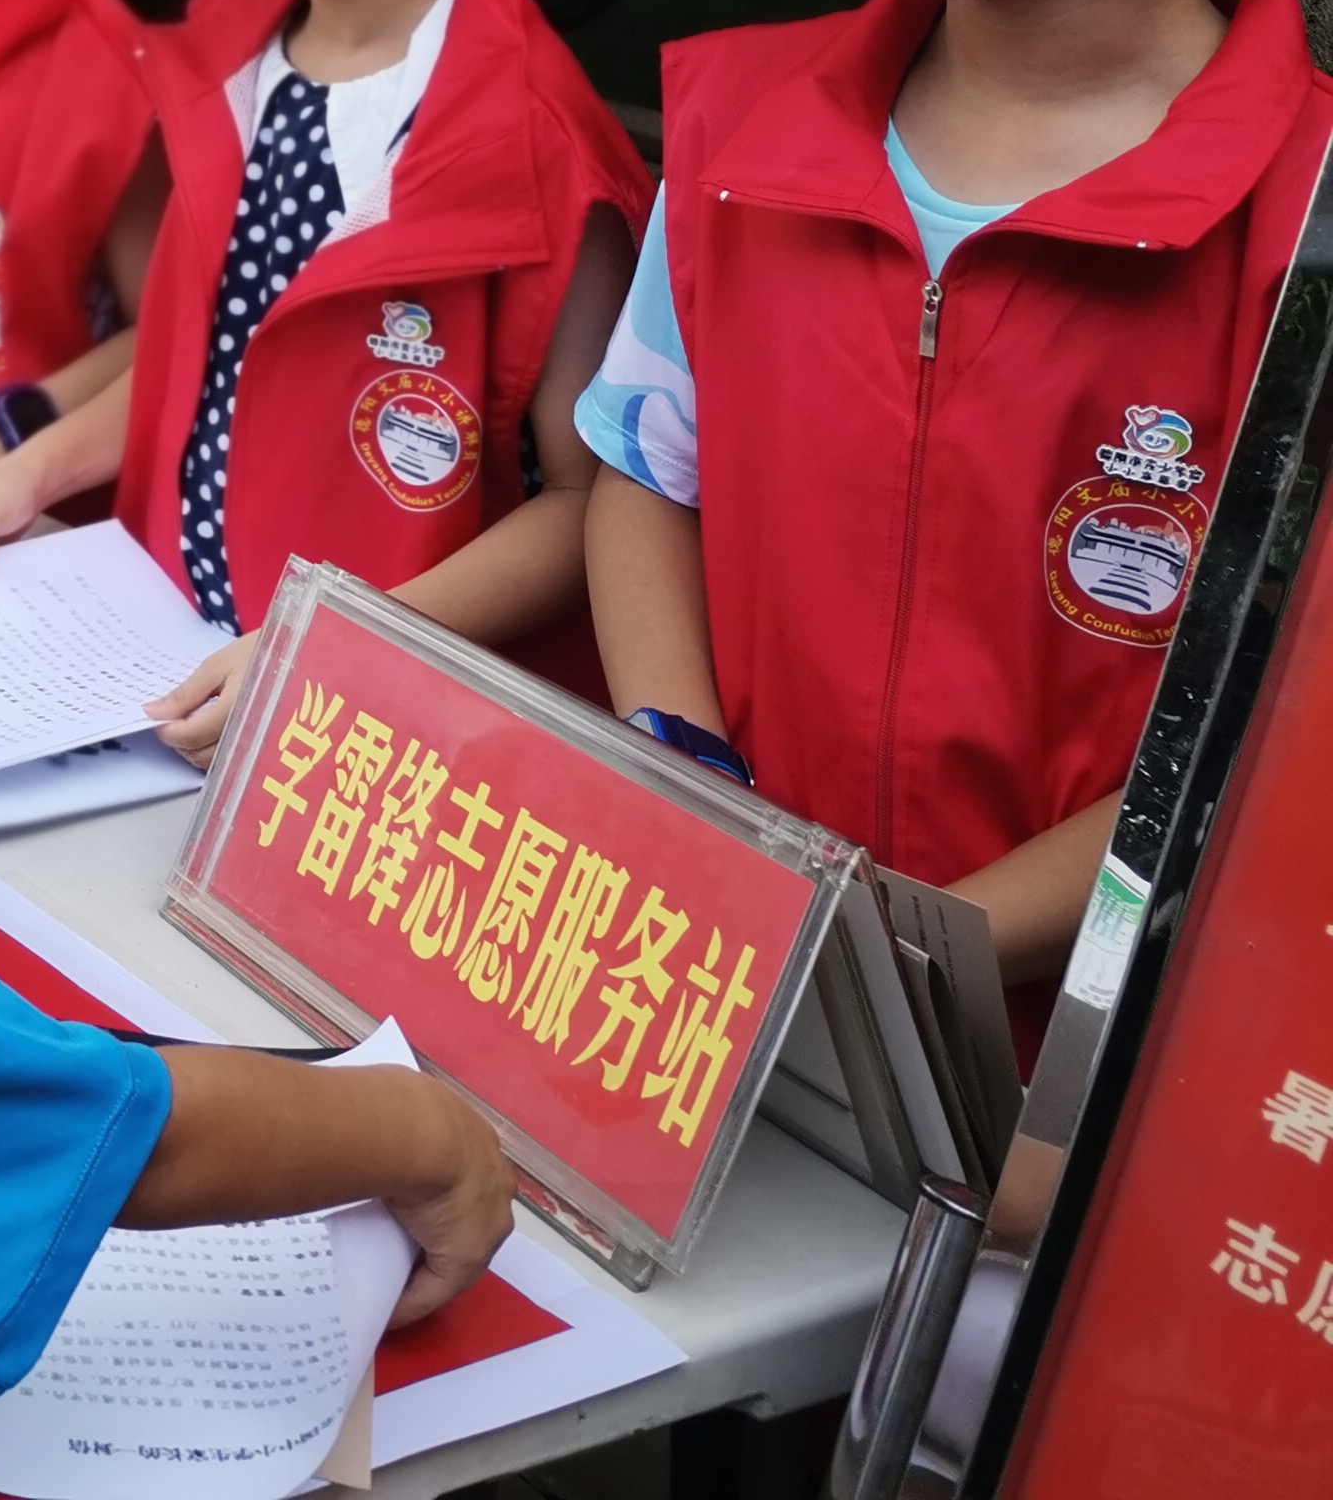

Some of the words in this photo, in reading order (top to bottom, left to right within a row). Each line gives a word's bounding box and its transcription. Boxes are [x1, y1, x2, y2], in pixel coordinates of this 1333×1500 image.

[1082, 612, 1156, 642] Confucius
[257, 678, 756, 1149] 学雷锋志愿服务站
